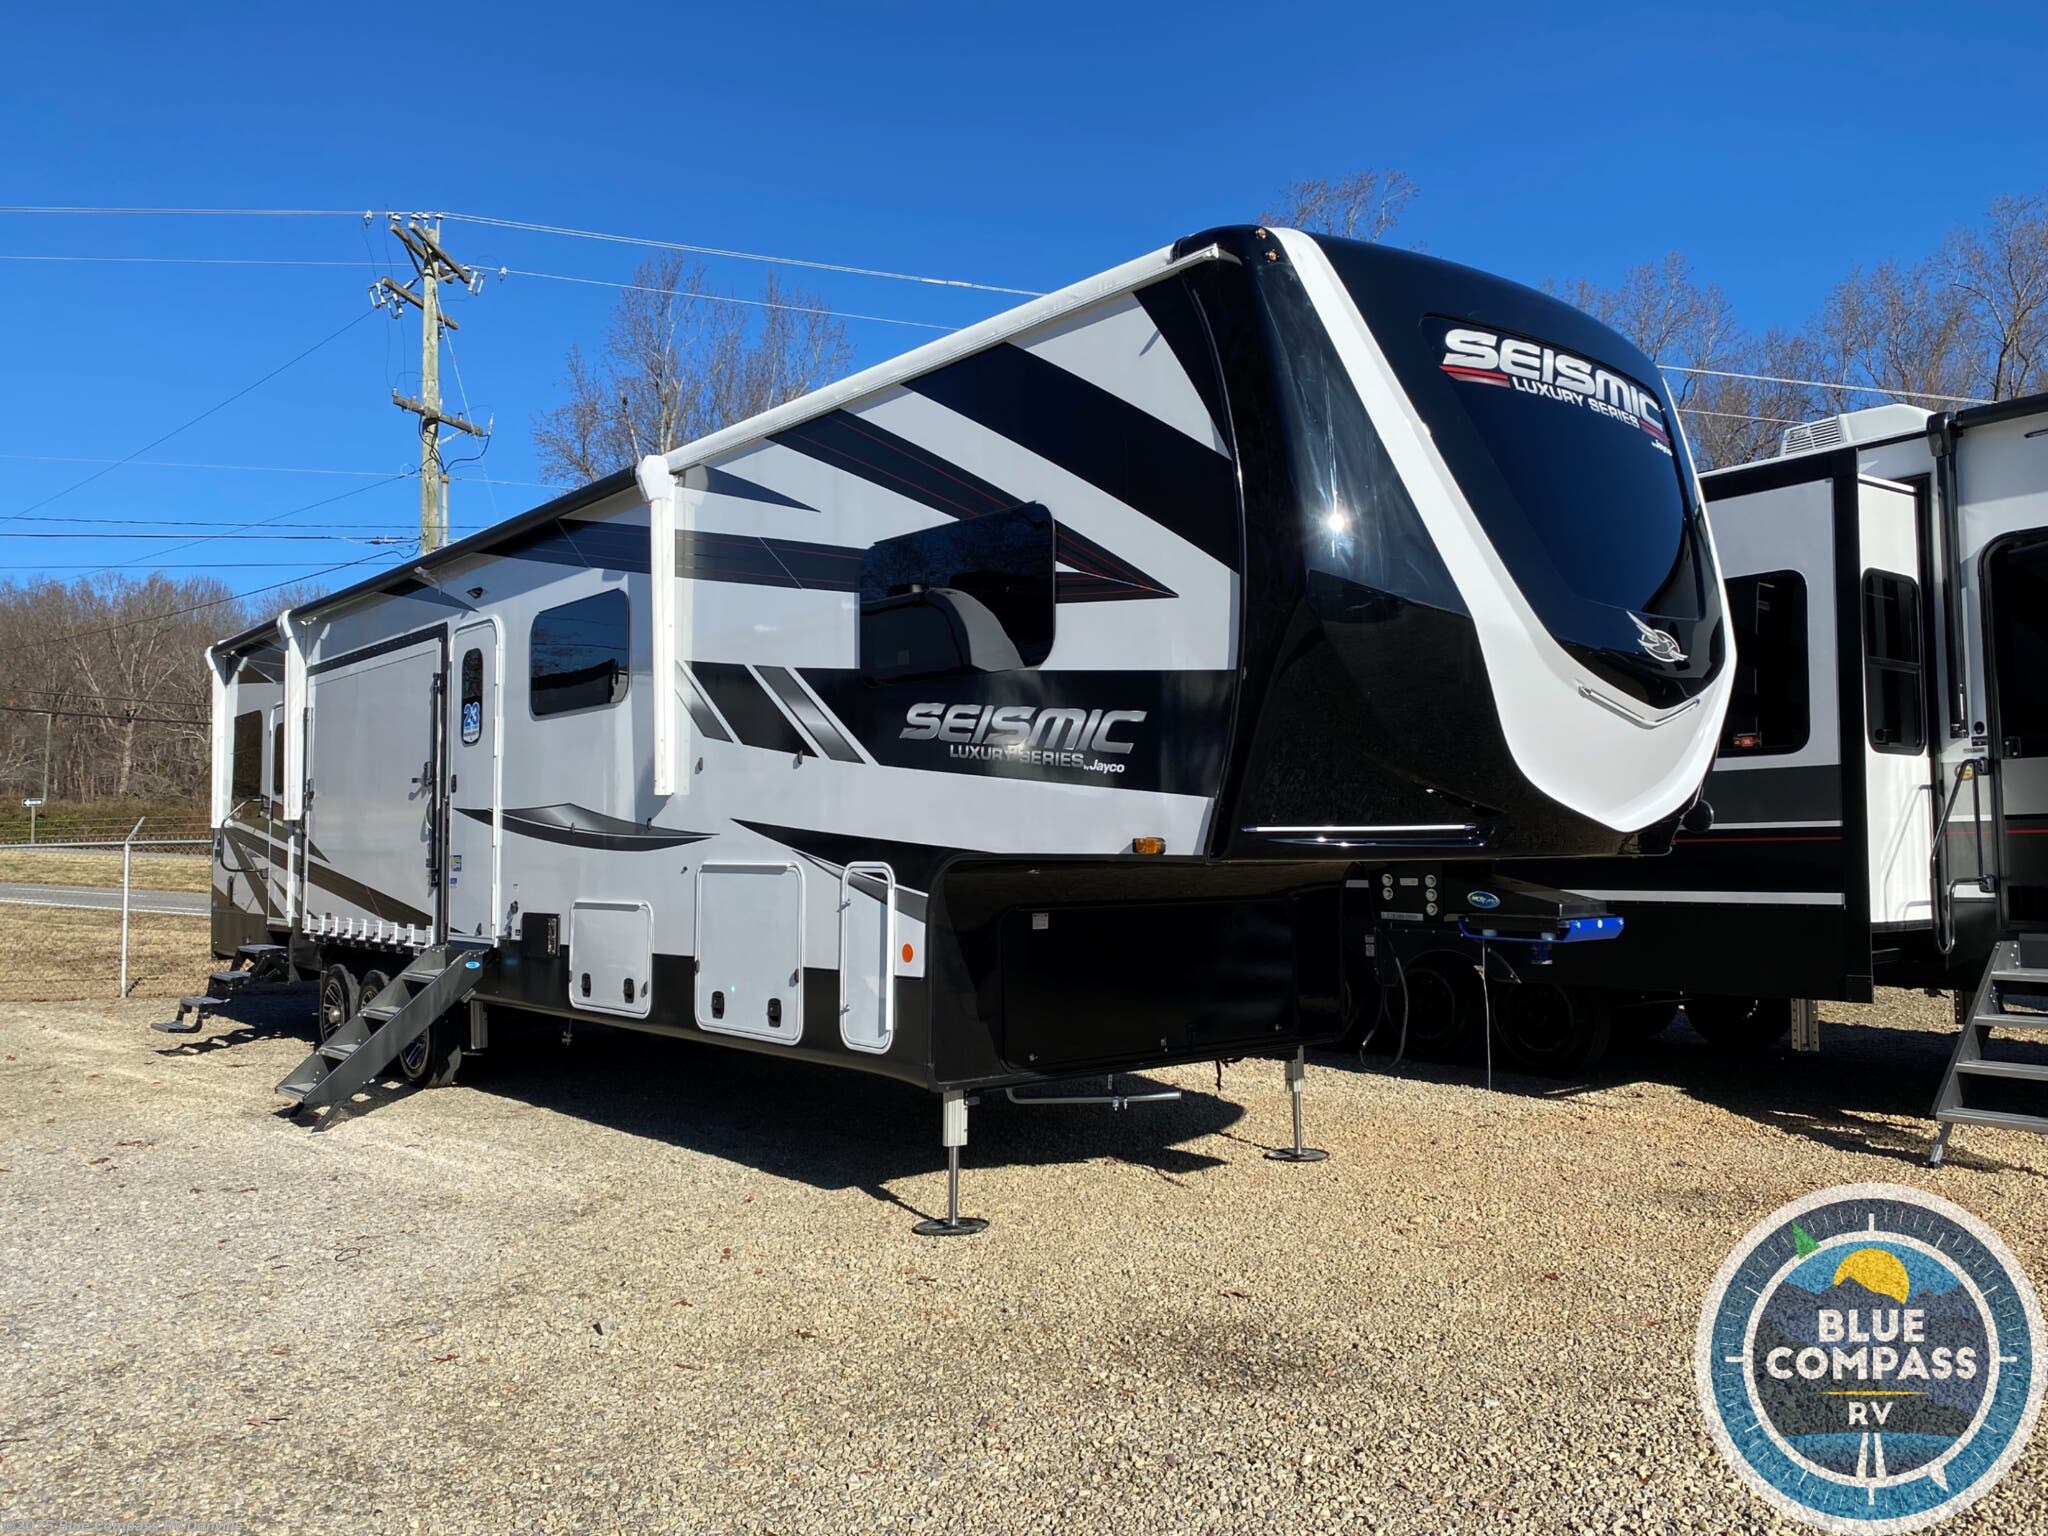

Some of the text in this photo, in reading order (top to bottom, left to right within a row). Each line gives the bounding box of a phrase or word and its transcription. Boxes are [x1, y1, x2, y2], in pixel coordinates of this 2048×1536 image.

[1442, 328, 1664, 430] SEISMIC
[1512, 376, 1640, 429] LUXURY SERIES
[899, 702, 1148, 754] SEISMIC
[949, 744, 1015, 761] LUXURY
[1019, 749, 1084, 768] SERIES
[1089, 759, 1125, 774] Jayco
